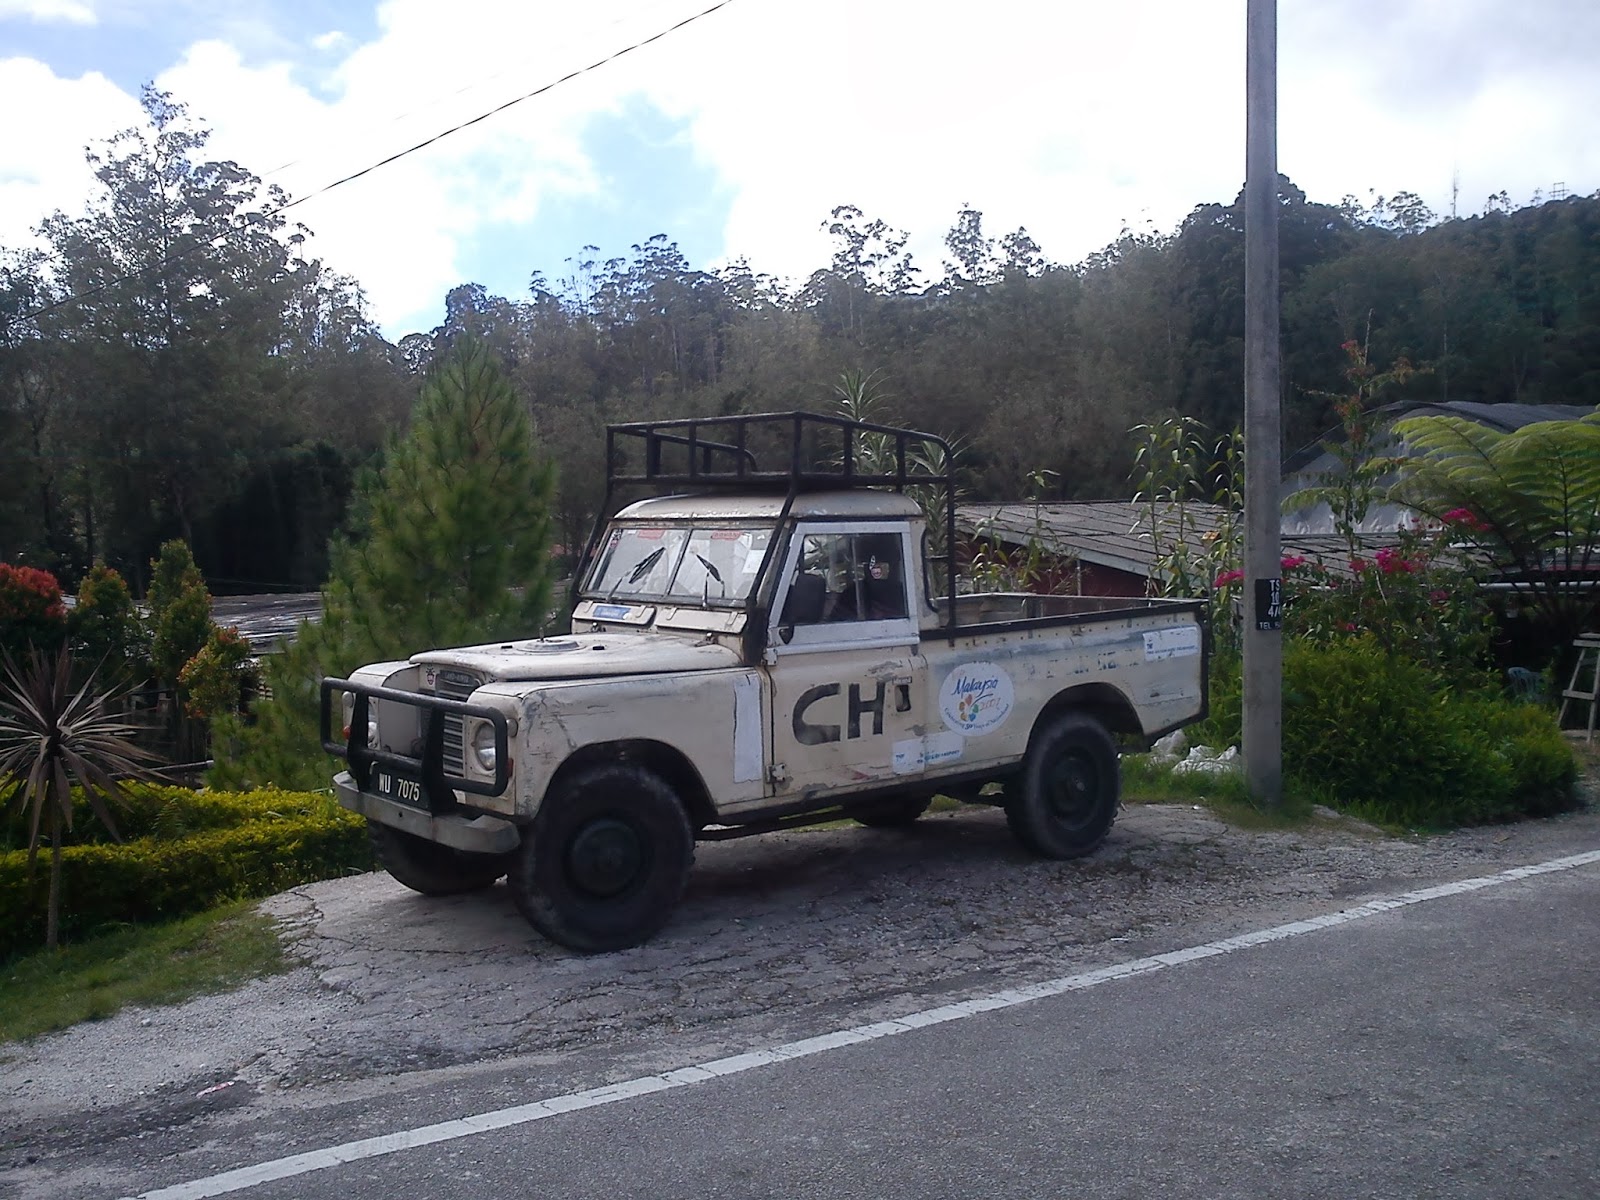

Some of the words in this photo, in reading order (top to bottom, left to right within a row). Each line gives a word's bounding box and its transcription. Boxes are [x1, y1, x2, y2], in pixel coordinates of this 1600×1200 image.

[951, 675, 998, 699] Malaysia
[792, 681, 886, 746] CH
[397, 778, 420, 801] 7075
